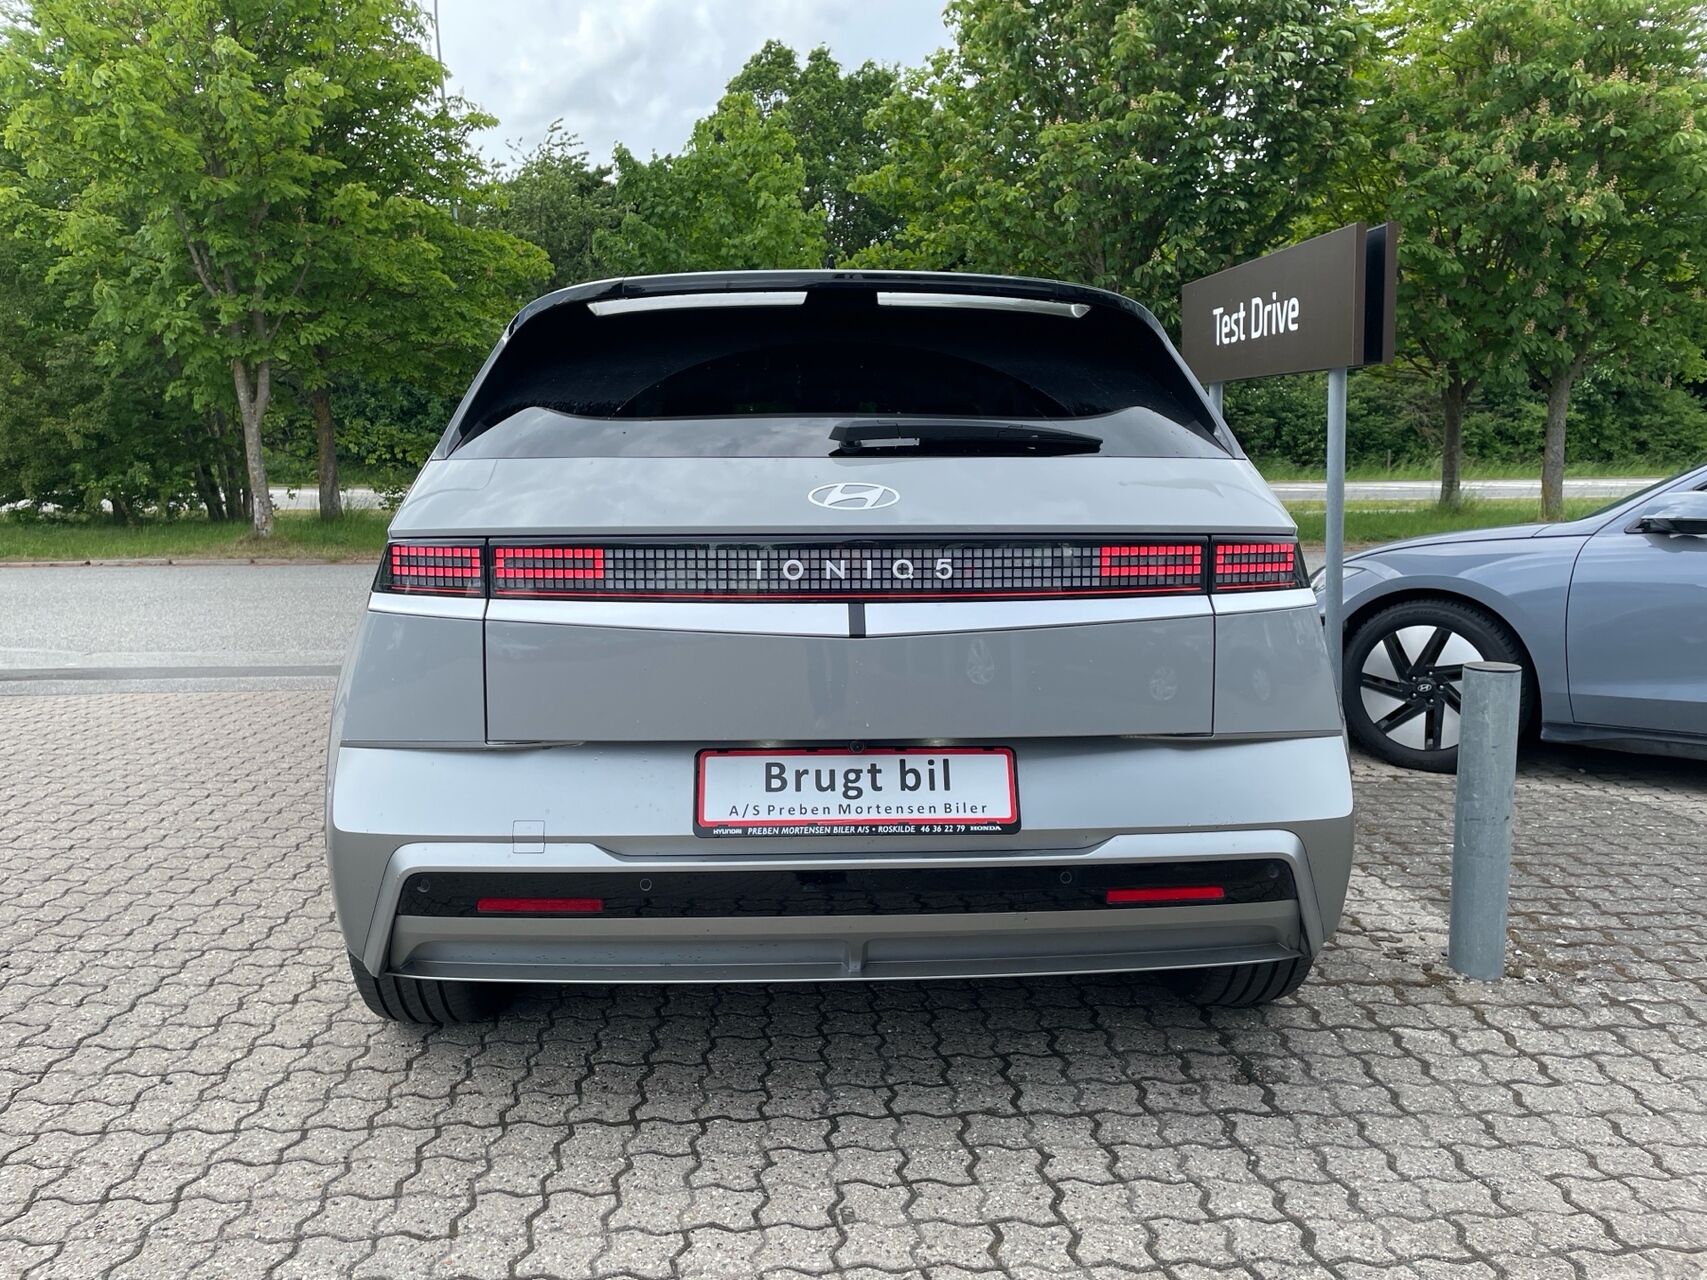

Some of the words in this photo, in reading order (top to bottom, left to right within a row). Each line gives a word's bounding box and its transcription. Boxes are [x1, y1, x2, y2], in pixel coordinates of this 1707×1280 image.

[1212, 301, 1246, 346] Test
[1251, 291, 1300, 339] Drive
[756, 559, 914, 580] IONIQ
[935, 558, 953, 580] 5
[764, 761, 883, 800] Brugt
[899, 758, 951, 792] bil
[729, 803, 760, 818] A/S
[767, 804, 831, 816] Preben
[838, 803, 937, 815] Mortensen
[944, 802, 987, 814] Biler
[747, 827, 779, 835] PREBEN
[781, 826, 832, 835] MORTENSEN
[833, 826, 855, 834] BILER
[857, 826, 870, 834] A/S
[877, 825, 916, 833] ROSKILDE
[920, 825, 930, 833] 46
[932, 825, 942, 833] 36
